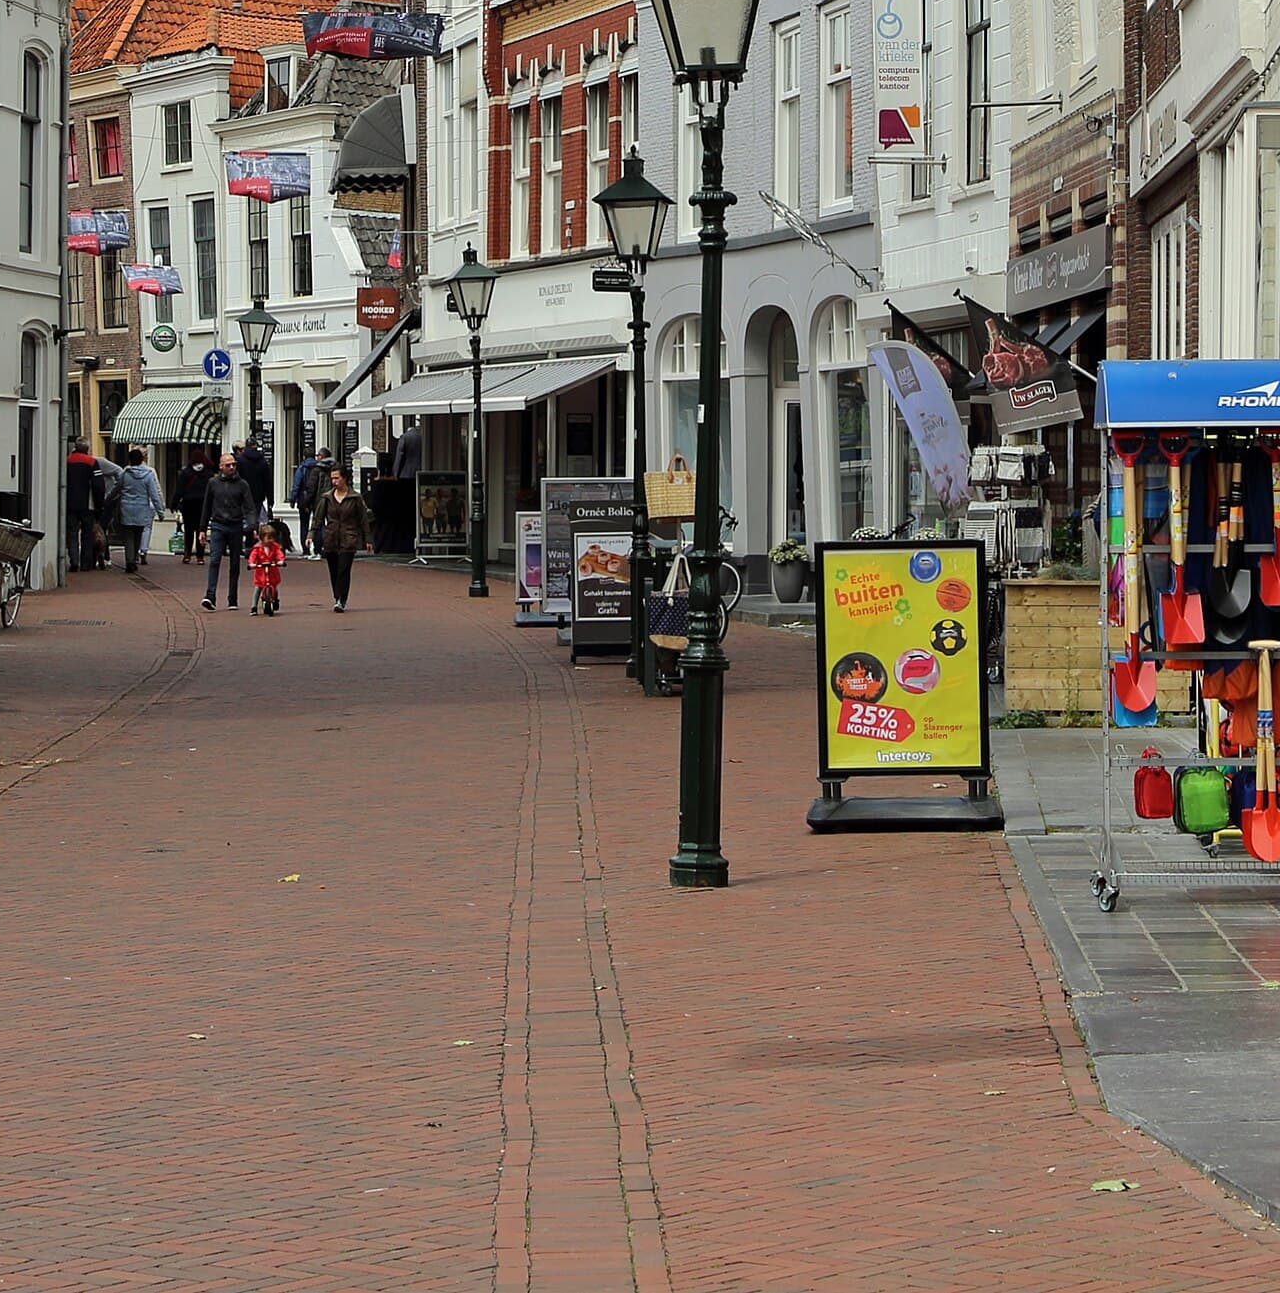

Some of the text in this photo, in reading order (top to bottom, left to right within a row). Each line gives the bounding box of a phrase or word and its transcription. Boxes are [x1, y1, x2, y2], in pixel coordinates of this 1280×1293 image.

[878, 39, 920, 50] van der
[878, 50, 914, 62] krieke
[878, 67, 920, 76] computers
[361, 306, 395, 314] HOOKED
[1013, 385, 1053, 403] UW SLAGER
[576, 505, 606, 517] Ornée
[849, 572, 880, 585] Echte
[834, 583, 904, 607] buiten
[848, 602, 894, 617] kansjes!
[849, 703, 898, 729] 25%
[846, 723, 897, 740] KORTING
[876, 750, 932, 763] Intertoys
